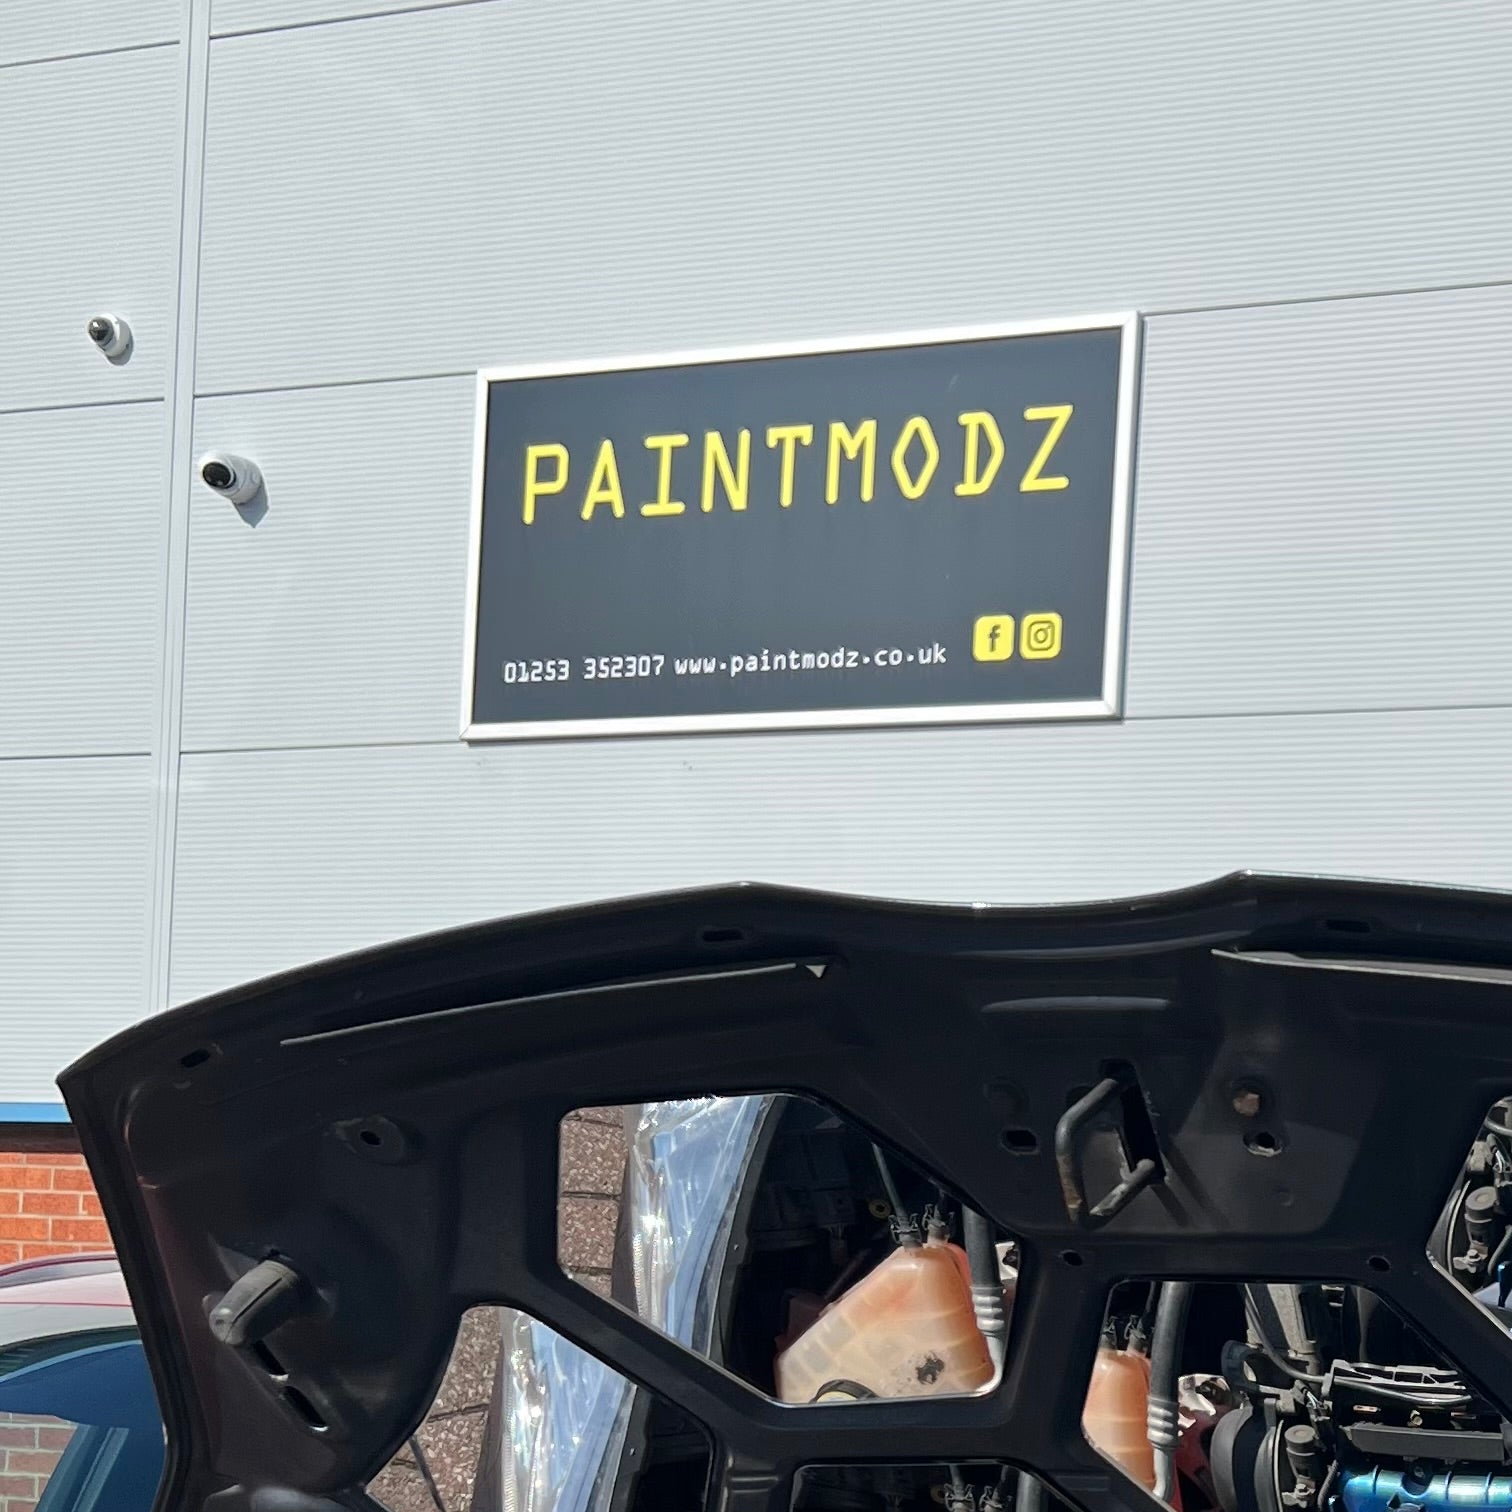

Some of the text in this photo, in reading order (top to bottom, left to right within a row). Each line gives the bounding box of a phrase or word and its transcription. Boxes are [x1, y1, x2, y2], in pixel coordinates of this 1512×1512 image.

[522, 405, 1073, 524] PAINTMODZ
[503, 642, 947, 684] 01253 352307 www.paintmodz.co.uk
